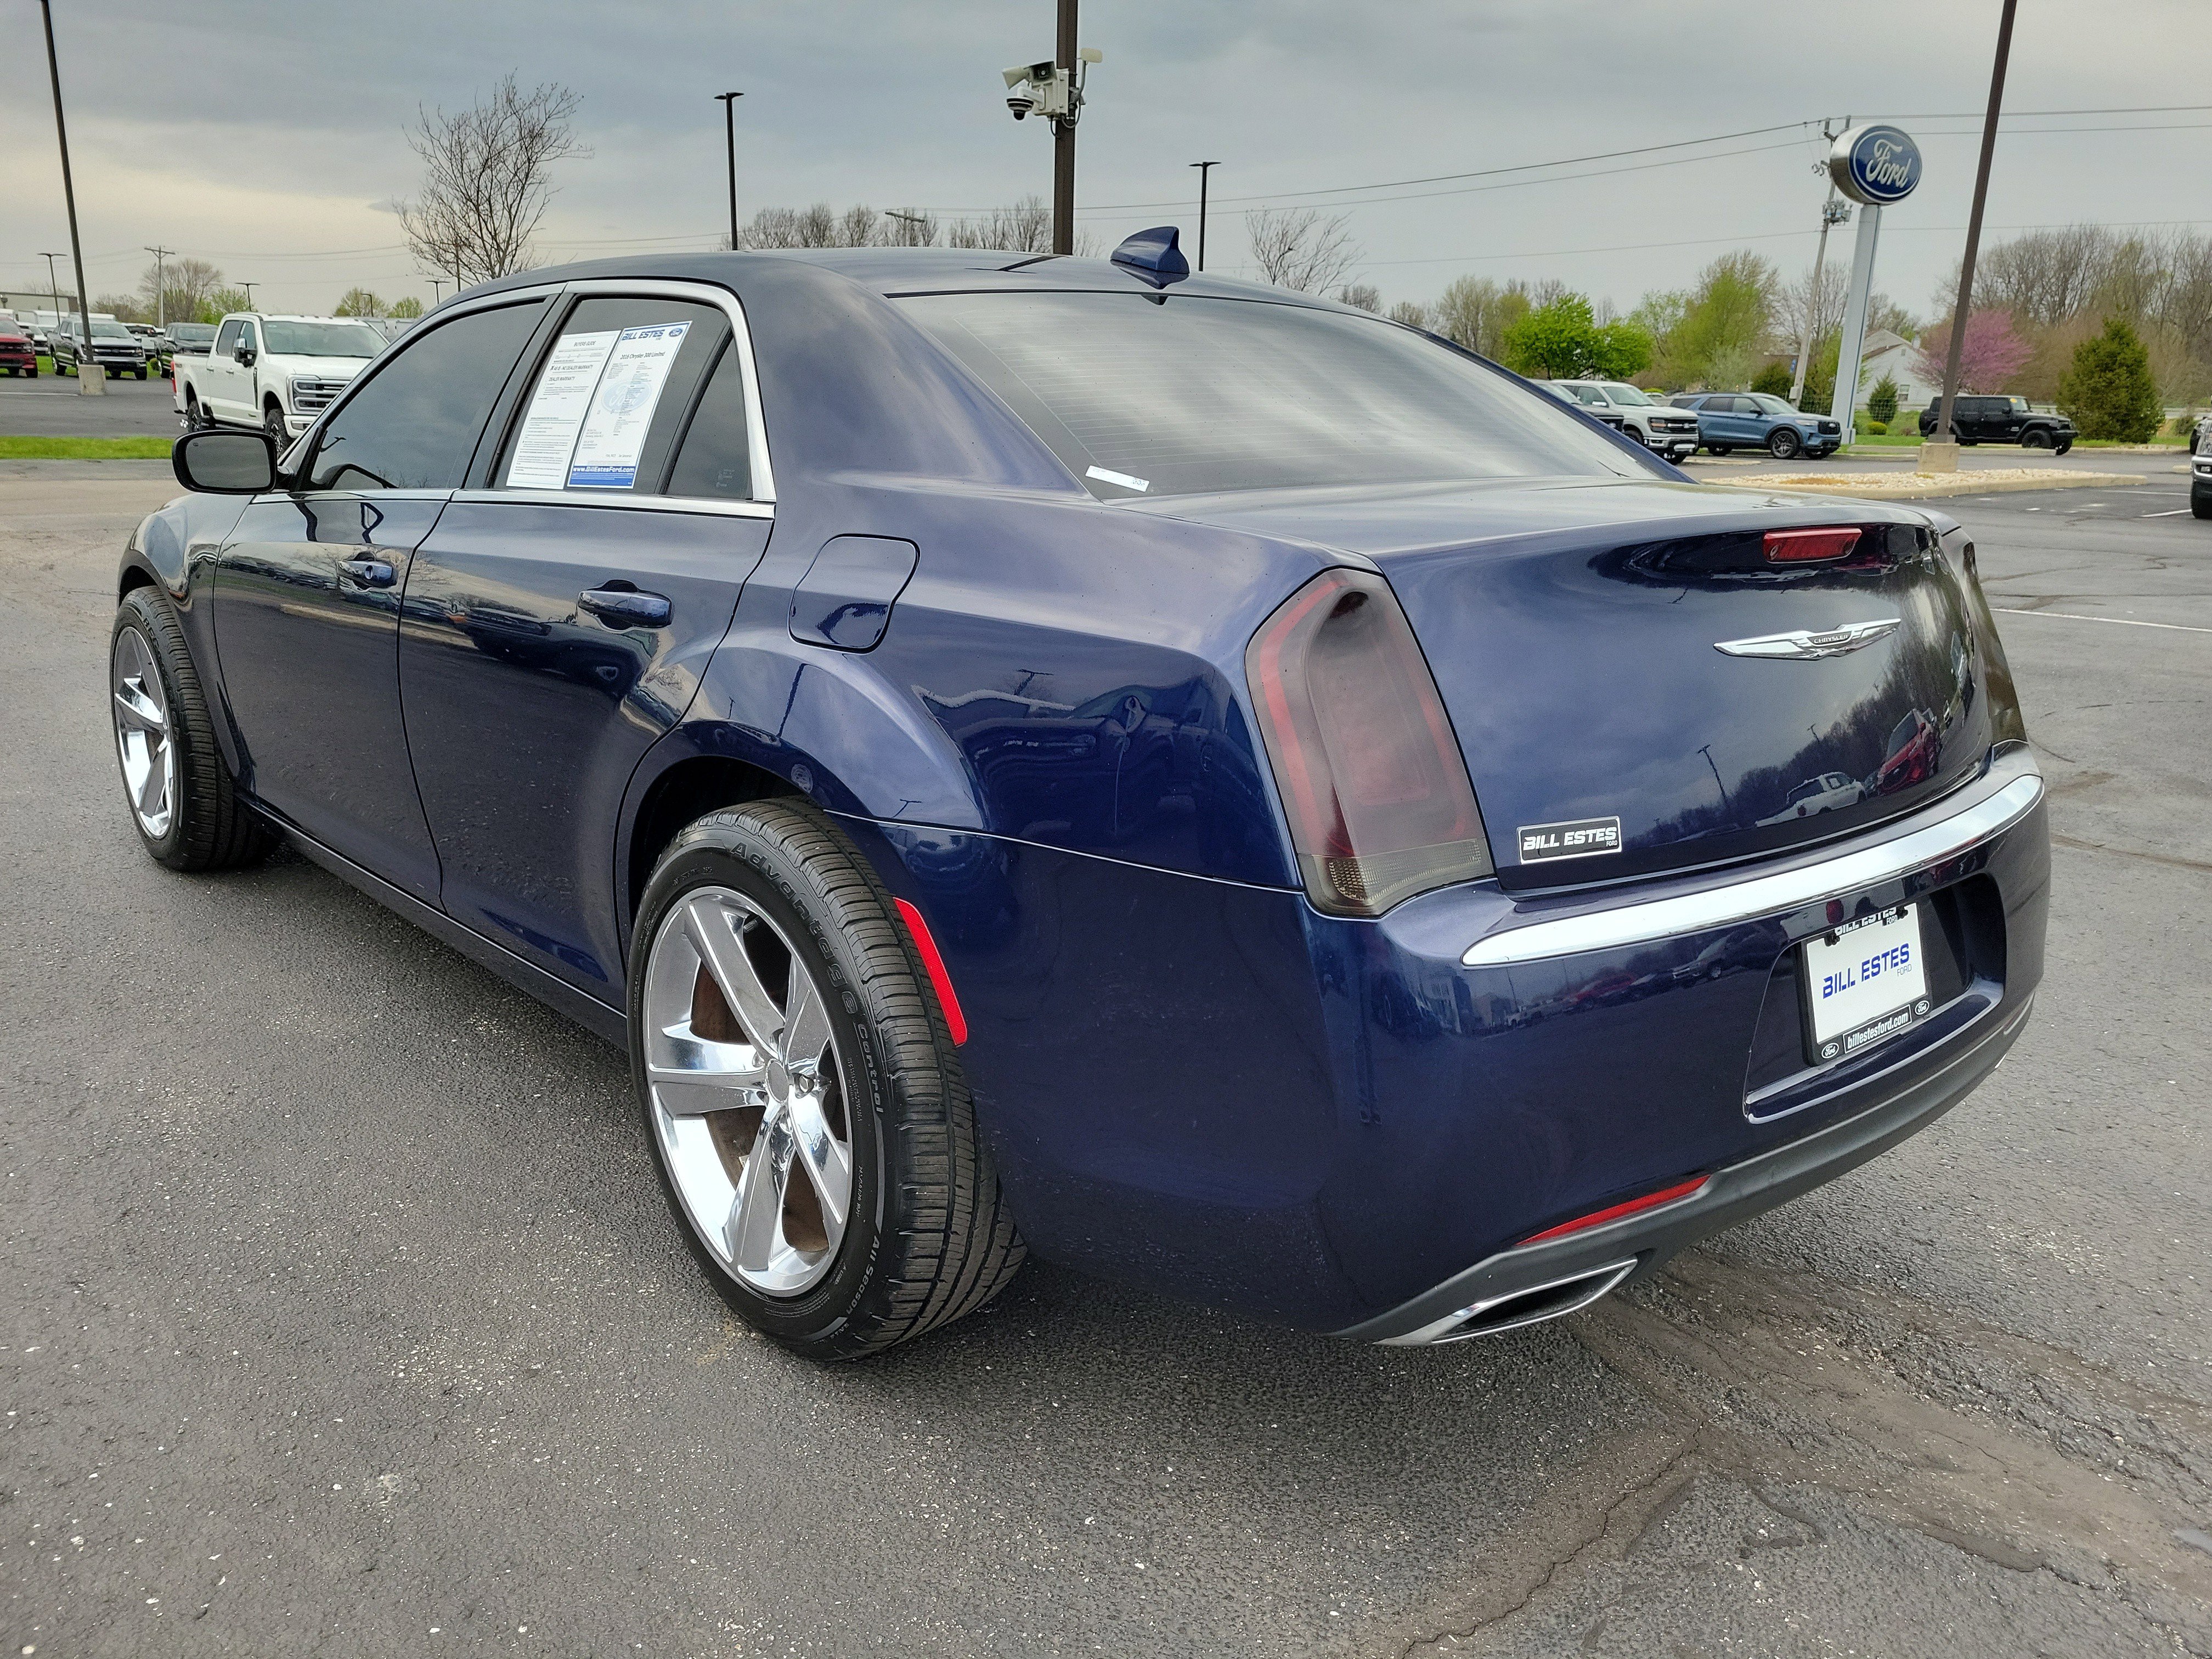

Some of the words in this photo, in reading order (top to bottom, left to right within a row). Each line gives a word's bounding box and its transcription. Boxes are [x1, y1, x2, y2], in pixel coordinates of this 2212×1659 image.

[1866, 139, 1911, 188] Ford
[621, 332, 637, 341] BILL
[638, 329, 665, 338] ESTES
[1814, 635, 1848, 643] CHRYSLER
[1523, 834, 1560, 850] BILL
[1564, 827, 1617, 846] ESTES
[1886, 915, 1898, 925] FORD
[730, 842, 858, 1014] Advantage
[858, 1024, 884, 1113] Control
[1823, 967, 1855, 999] BILL
[1861, 943, 1909, 982] ESTES
[1897, 964, 1912, 977] FORD
[1847, 1012, 1908, 1049] billestesford.com
[1825, 1043, 1836, 1057] Ford
[870, 1235, 879, 1261] All
[846, 1263, 873, 1314] Season
